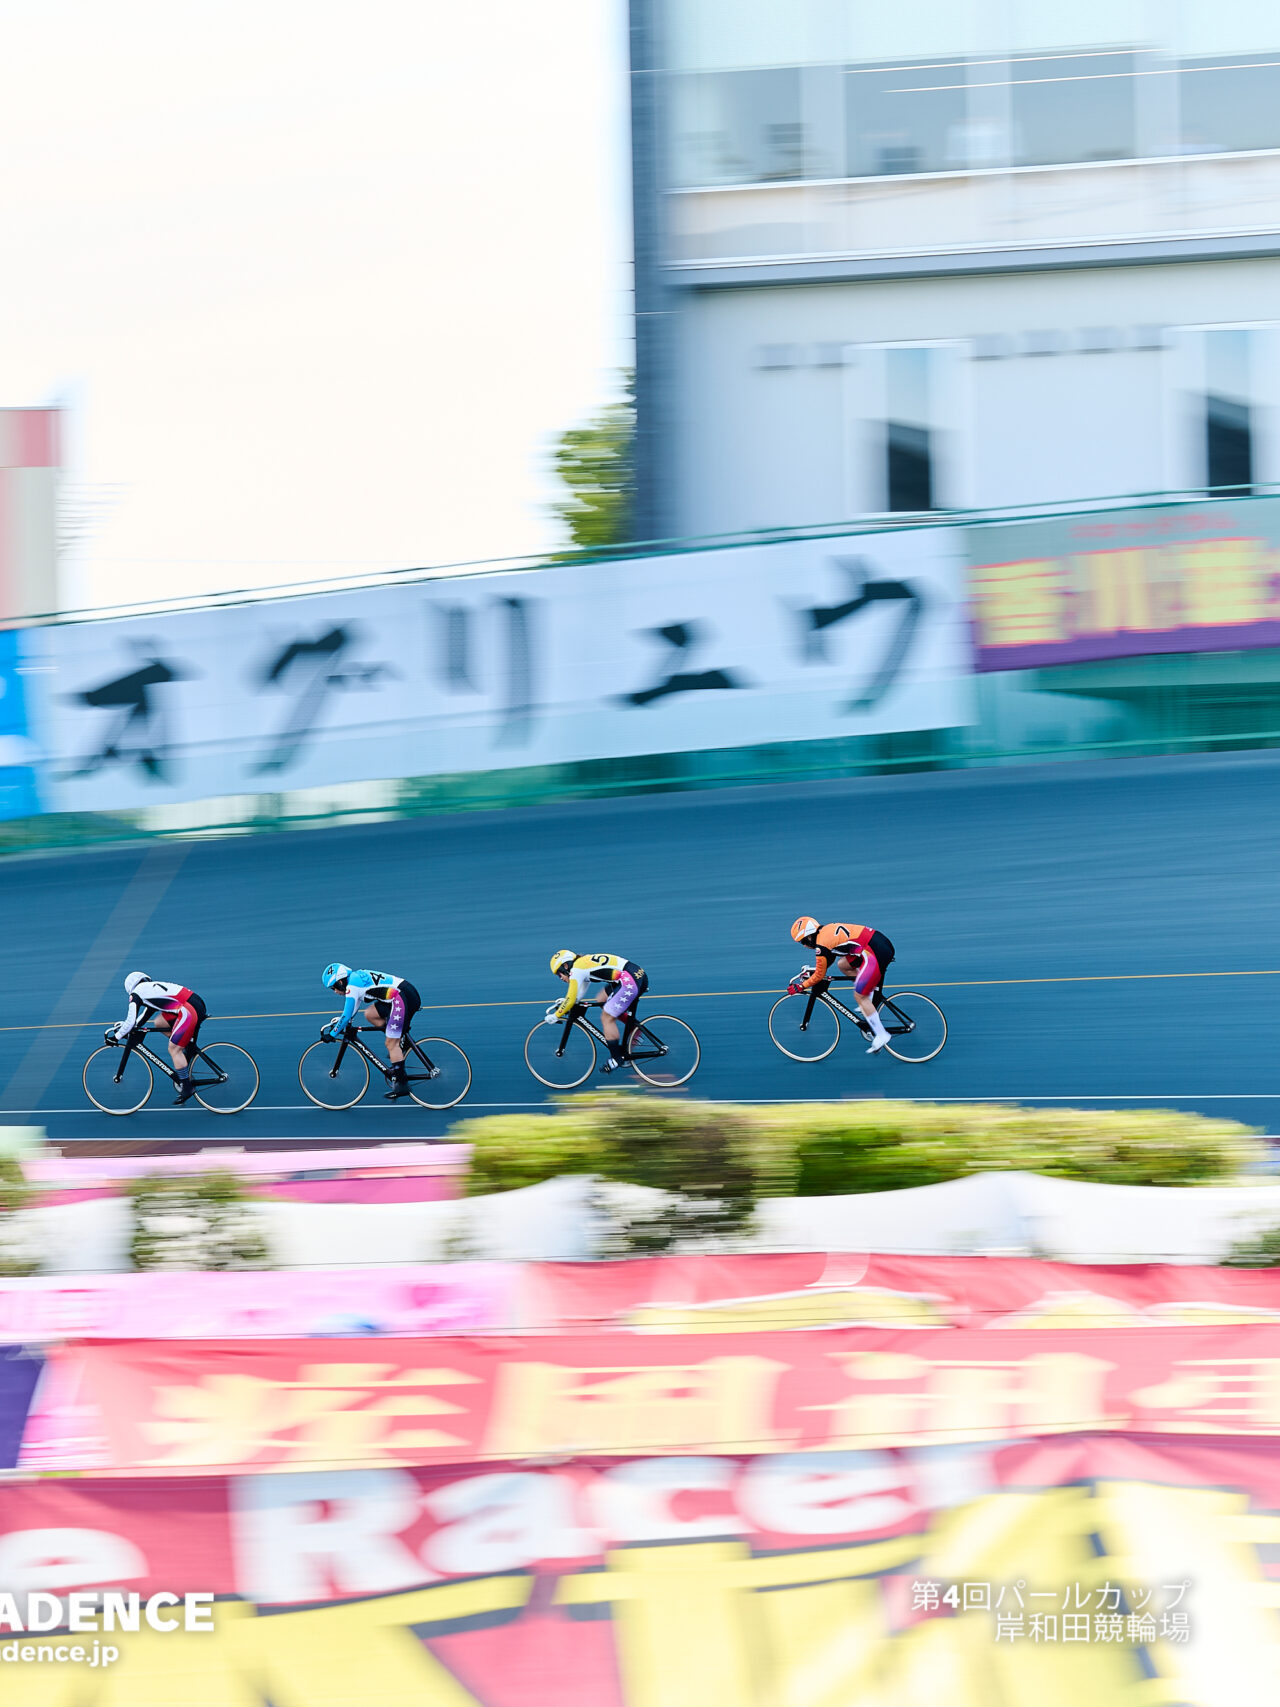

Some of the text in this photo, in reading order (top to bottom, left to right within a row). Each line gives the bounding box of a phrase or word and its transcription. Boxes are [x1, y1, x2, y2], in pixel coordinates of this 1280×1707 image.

[834, 925, 850, 938] 7
[591, 954, 609, 966] 5
[327, 965, 334, 976] 4
[369, 971, 385, 986] 4
[820, 991, 860, 1024] BRIDGESTONE
[577, 1016, 609, 1046] BRIDGESTO
